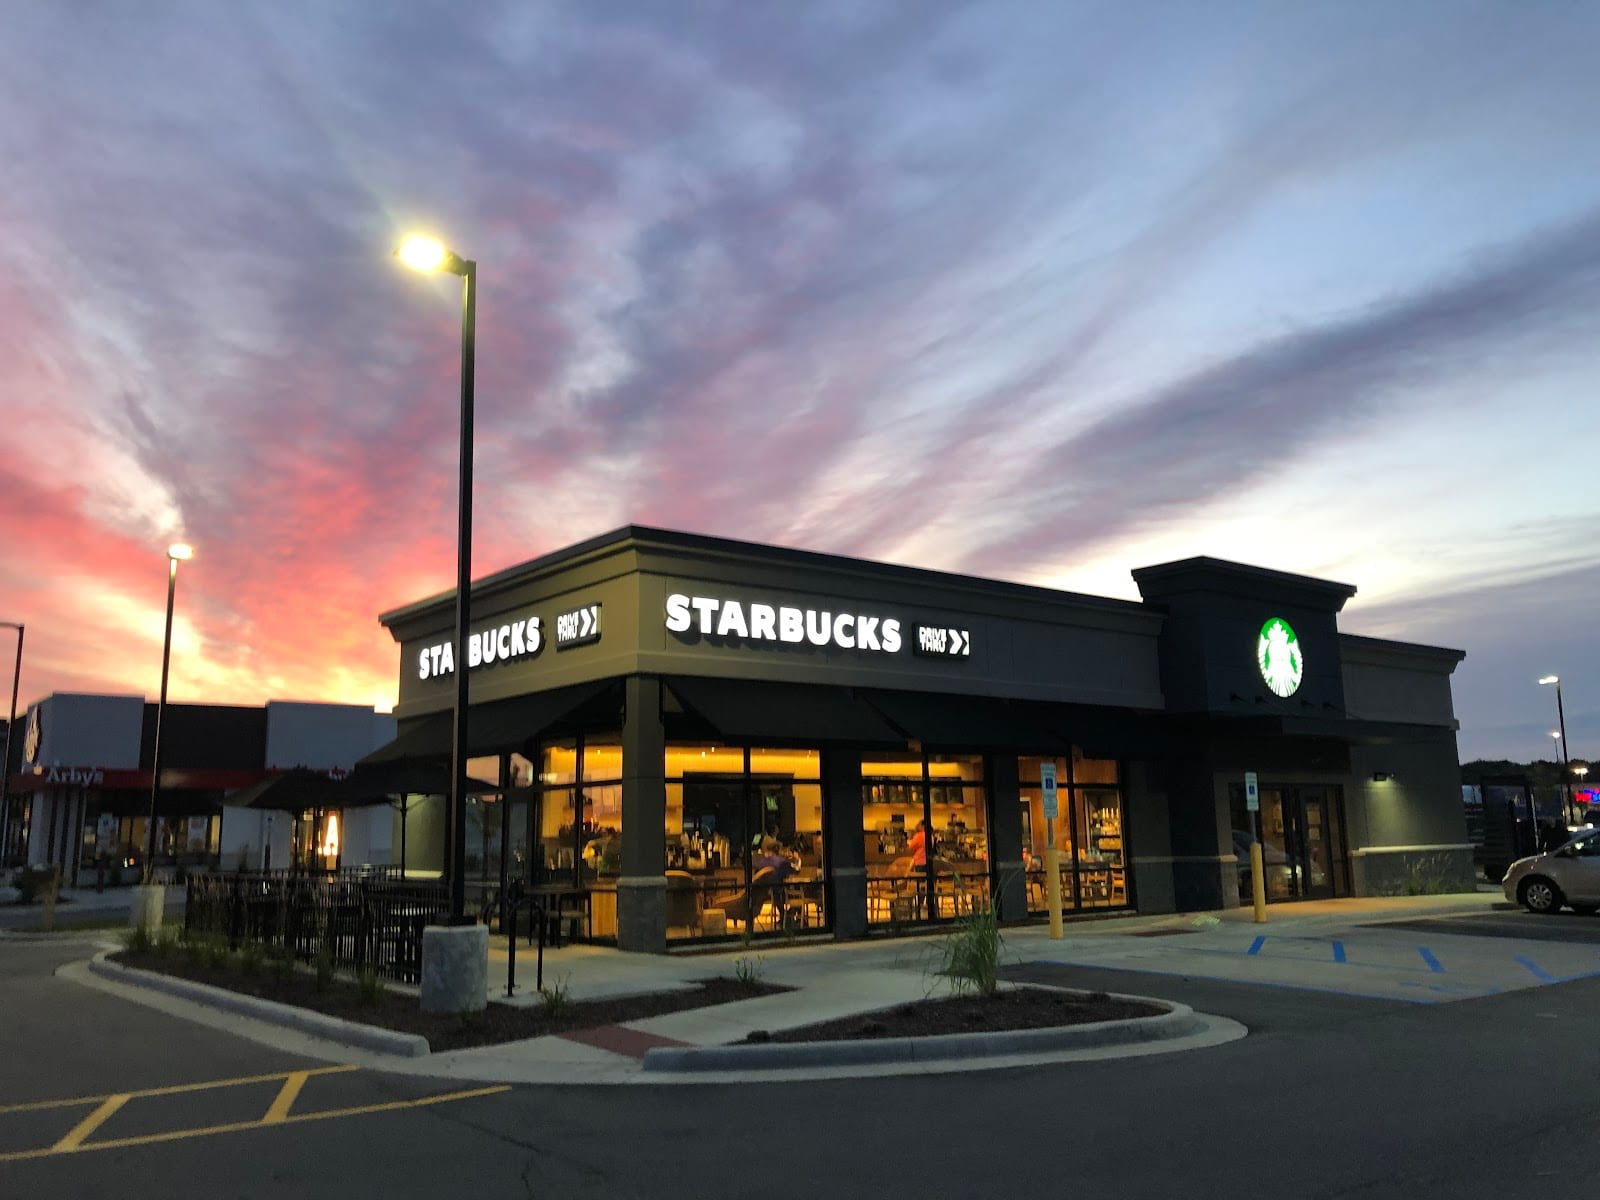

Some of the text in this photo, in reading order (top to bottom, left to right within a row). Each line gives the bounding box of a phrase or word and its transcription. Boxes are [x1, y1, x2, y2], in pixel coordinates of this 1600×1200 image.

[419, 616, 541, 680] STABUCKS
[665, 593, 902, 653] STARBUCKS
[919, 626, 947, 642] DRIVE
